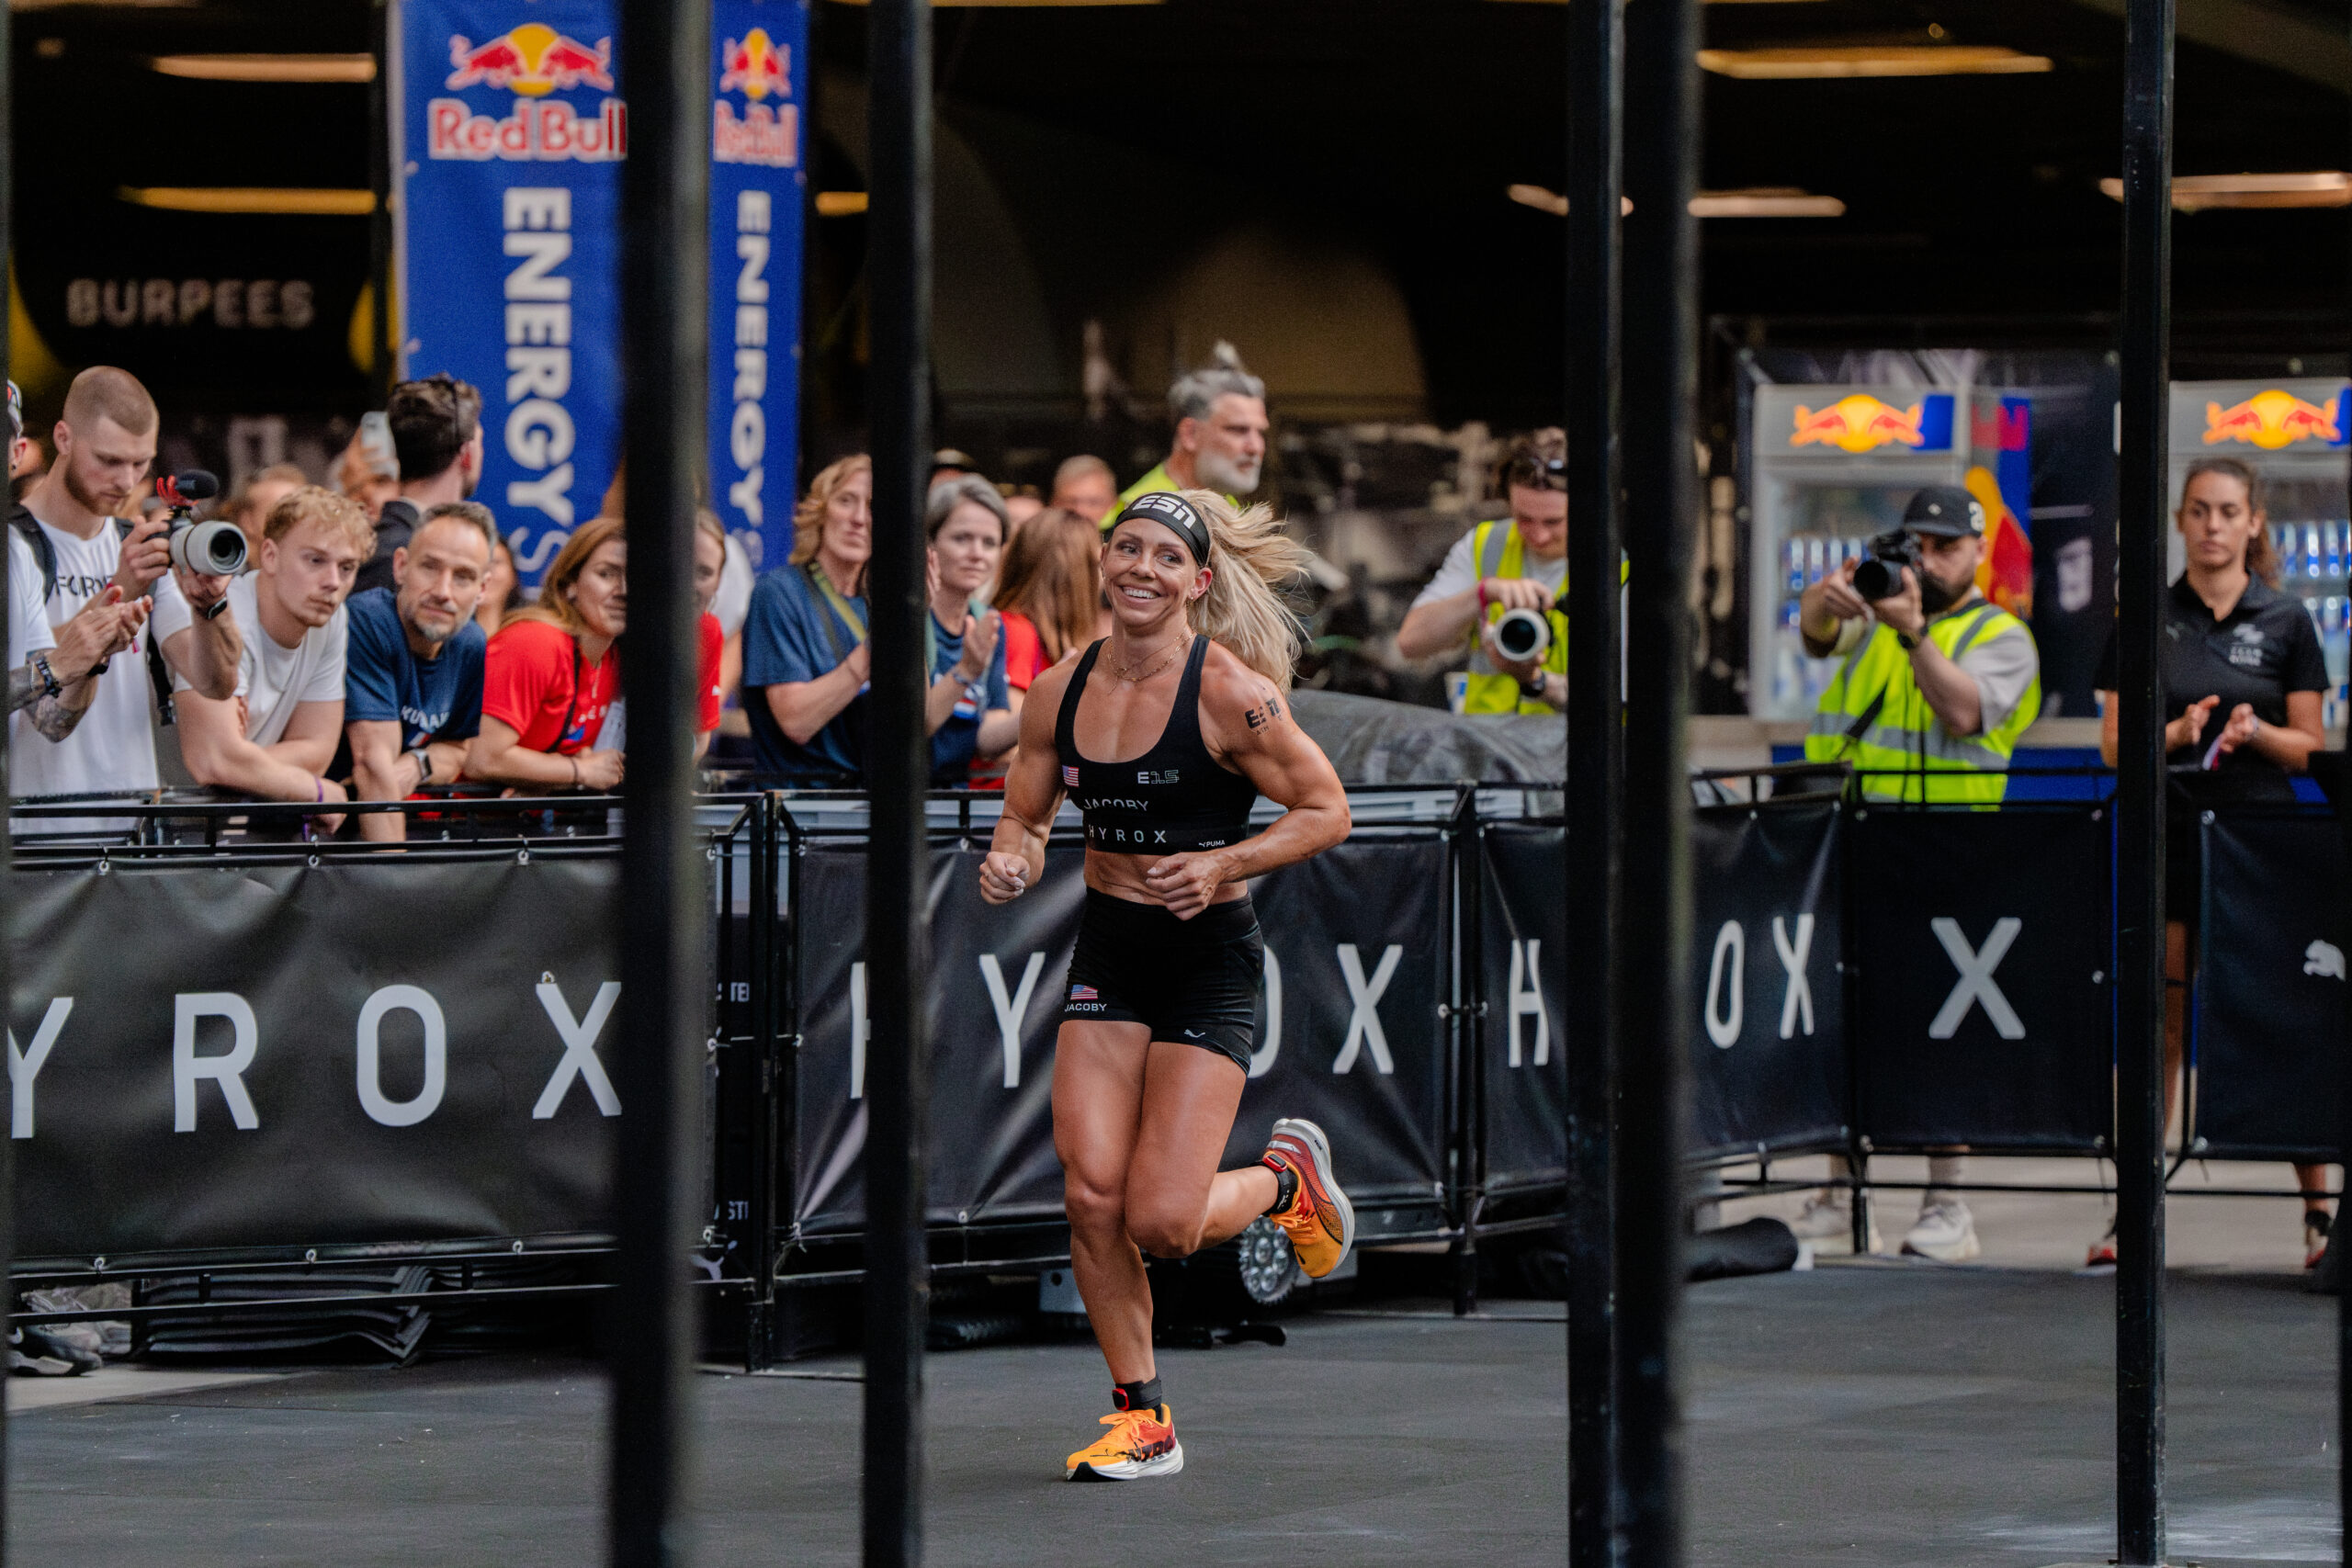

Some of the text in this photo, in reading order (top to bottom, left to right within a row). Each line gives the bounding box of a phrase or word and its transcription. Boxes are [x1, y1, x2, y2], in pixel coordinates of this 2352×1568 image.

[428, 97, 628, 163] Red Bull
[67, 278, 315, 328] BURPEES
[504, 187, 575, 526] ENERGY
[1088, 824, 1167, 844] HYROX
[1205, 840, 1226, 849] PUMA
[1064, 1002, 1107, 1012] JACOBY
